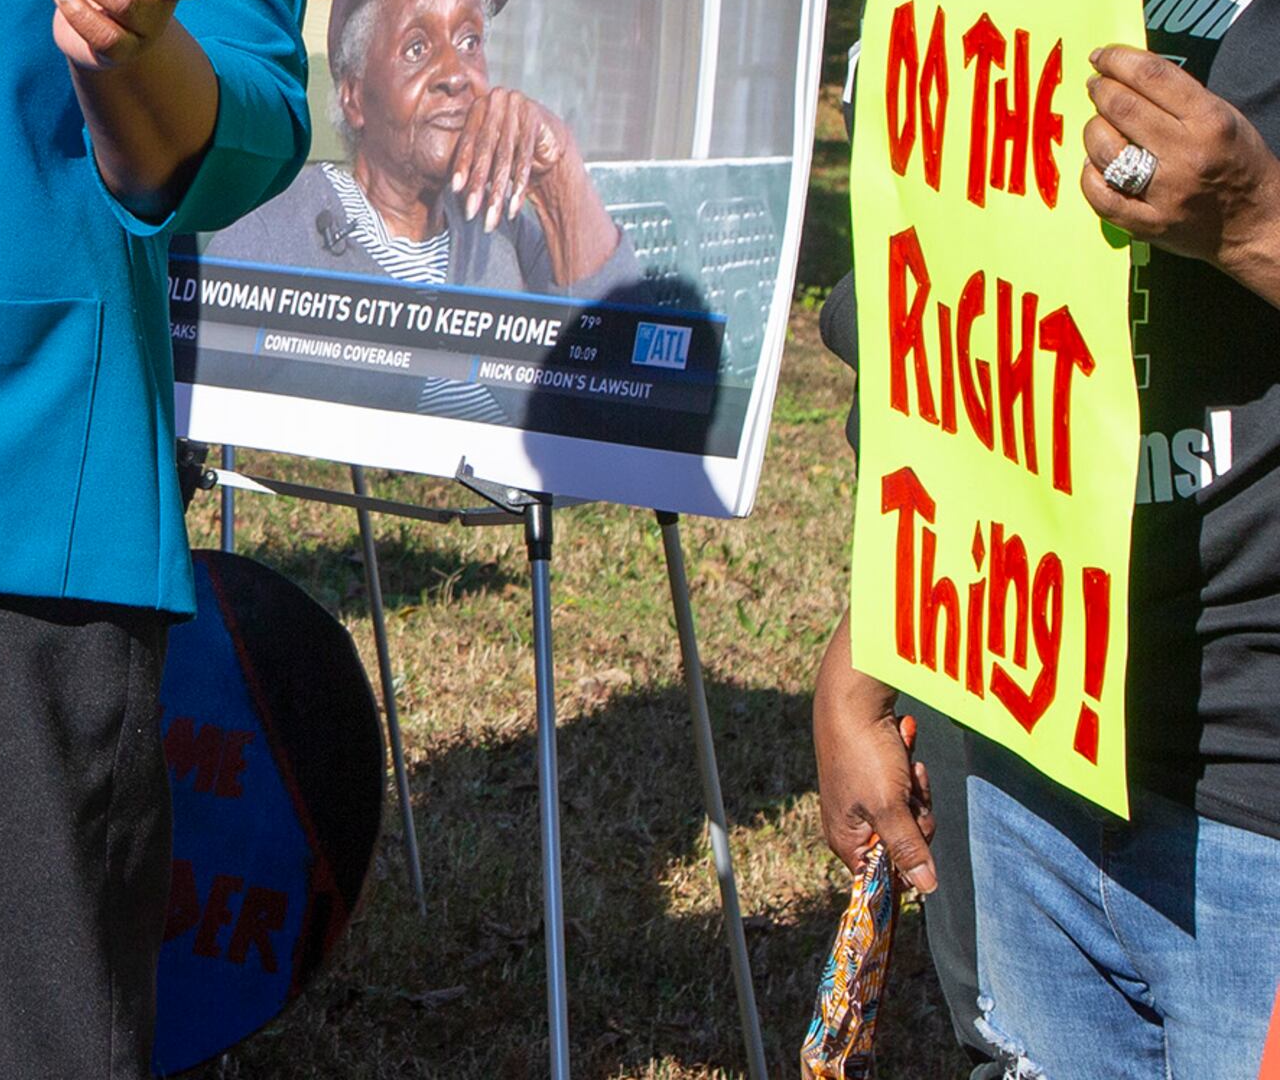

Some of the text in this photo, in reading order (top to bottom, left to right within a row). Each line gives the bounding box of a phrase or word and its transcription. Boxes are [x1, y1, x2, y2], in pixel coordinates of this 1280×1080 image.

[886, 0, 1064, 210] DO THE
[201, 280, 276, 312] WOMAN
[279, 290, 352, 321] FIGHTS
[355, 299, 403, 329] CITY
[407, 303, 434, 330] TO
[436, 307, 494, 339] KEEP
[497, 312, 561, 347] HOME
[650, 325, 685, 363] ATL
[264, 335, 411, 368] CONTINUING COVERAGE
[479, 362, 653, 399] NICK GORDON'S LAWSUIT
[569, 345, 598, 361] 10:09
[889, 224, 1096, 496] RIGHT
[1136, 408, 1232, 505] ns!
[882, 466, 1111, 765] Thing!
